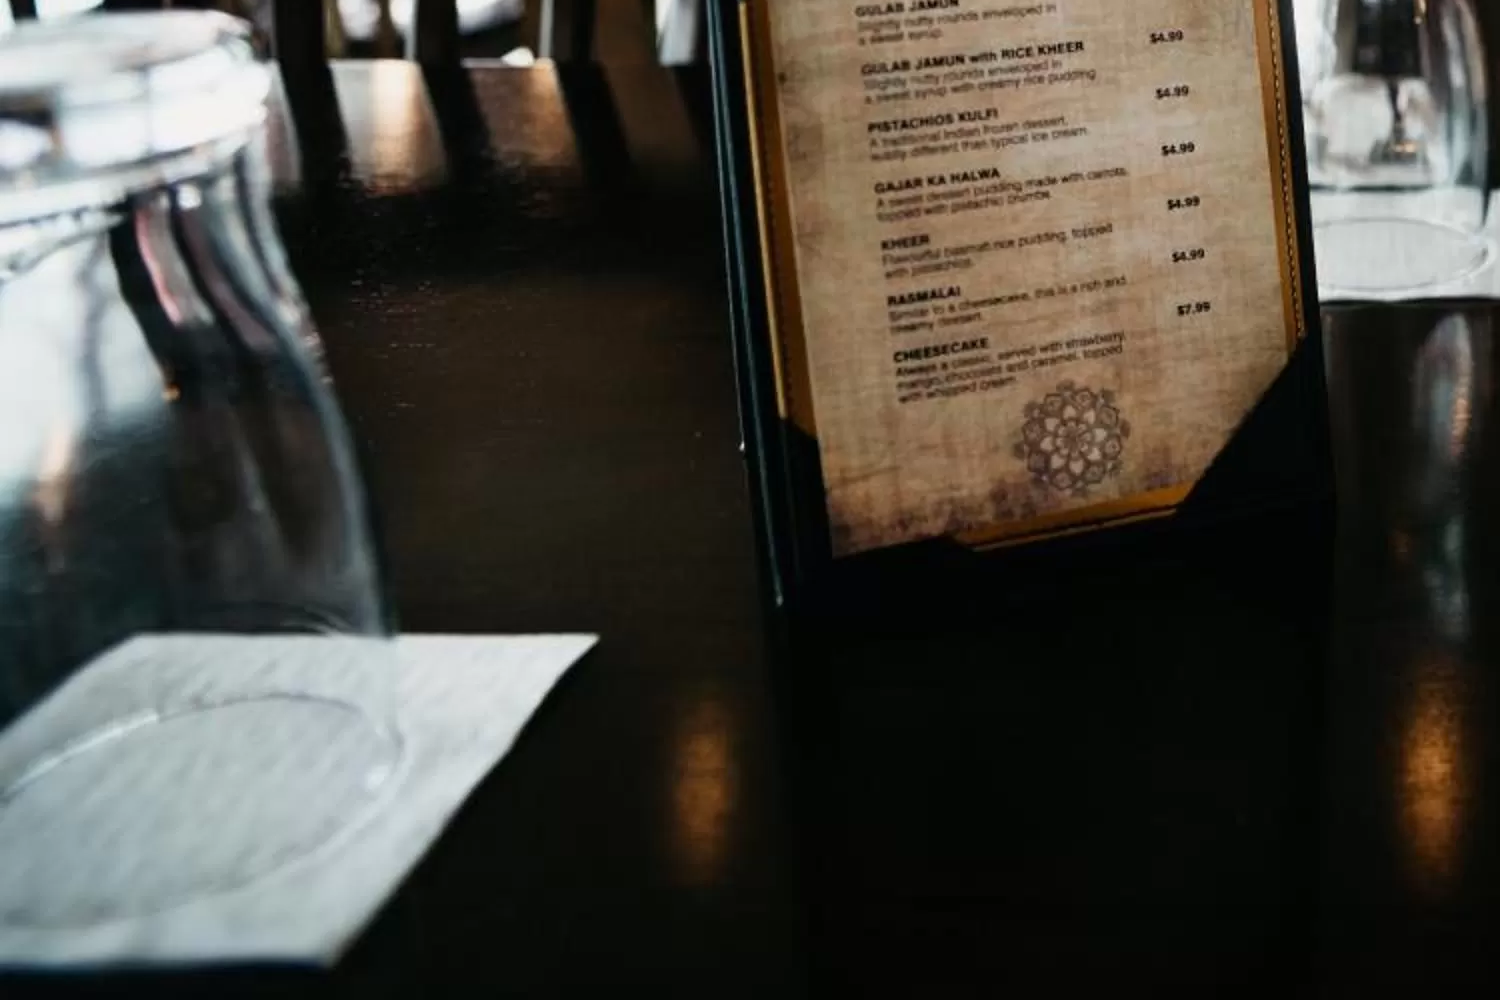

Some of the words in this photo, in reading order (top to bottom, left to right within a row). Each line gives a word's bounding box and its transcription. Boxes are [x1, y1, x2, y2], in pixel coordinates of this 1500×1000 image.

[855, 2, 905, 17] GULAB
[982, 4, 1042, 21] enveloped
[861, 60, 911, 75] GULAB
[915, 54, 965, 70] JAMUN
[969, 51, 997, 62] with
[1001, 46, 1033, 59] RICE
[1037, 40, 1084, 55] KHEER
[1150, 30, 1184, 44] $4.99
[914, 86, 946, 100] syrup
[978, 78, 1020, 92] creamy
[1024, 75, 1045, 85] rice
[1048, 69, 1096, 85] pudding
[943, 69, 984, 82] rounds
[988, 60, 1048, 77] enveloped
[868, 113, 954, 132] PISTACHIOS
[958, 107, 998, 122] KULFI
[1156, 85, 1189, 100] $4.99
[871, 138, 878, 147] A
[943, 127, 980, 139] Indian
[910, 142, 959, 157] different
[961, 138, 987, 149] than
[990, 134, 1028, 148] typical
[1032, 132, 1048, 141] ice
[874, 177, 923, 194] GAJAR
[927, 175, 946, 186] KA
[950, 167, 1001, 183] HALWA
[1161, 142, 1195, 156] $4.99
[877, 199, 884, 208] A
[974, 182, 1023, 197] pudding
[1025, 176, 1057, 187] made
[1061, 172, 1084, 183] with
[951, 196, 1004, 214] pistachio
[881, 233, 930, 250] KHEER
[1167, 195, 1200, 210] $4.99
[993, 239, 1015, 249] rice
[887, 285, 961, 306] RASMALAI
[1172, 248, 1205, 263] $4.99
[933, 305, 944, 314] to
[1034, 286, 1055, 298] this
[1080, 279, 1101, 292] rich
[1104, 275, 1126, 288] and
[893, 337, 989, 363] CHEESECAKE
[1177, 301, 1211, 316] $7.99
[940, 362, 948, 371] a
[997, 346, 1036, 361] served
[1039, 342, 1062, 353] with
[945, 366, 1002, 383] chocolate
[1006, 360, 1028, 372] and
[926, 381, 977, 398] whipped
